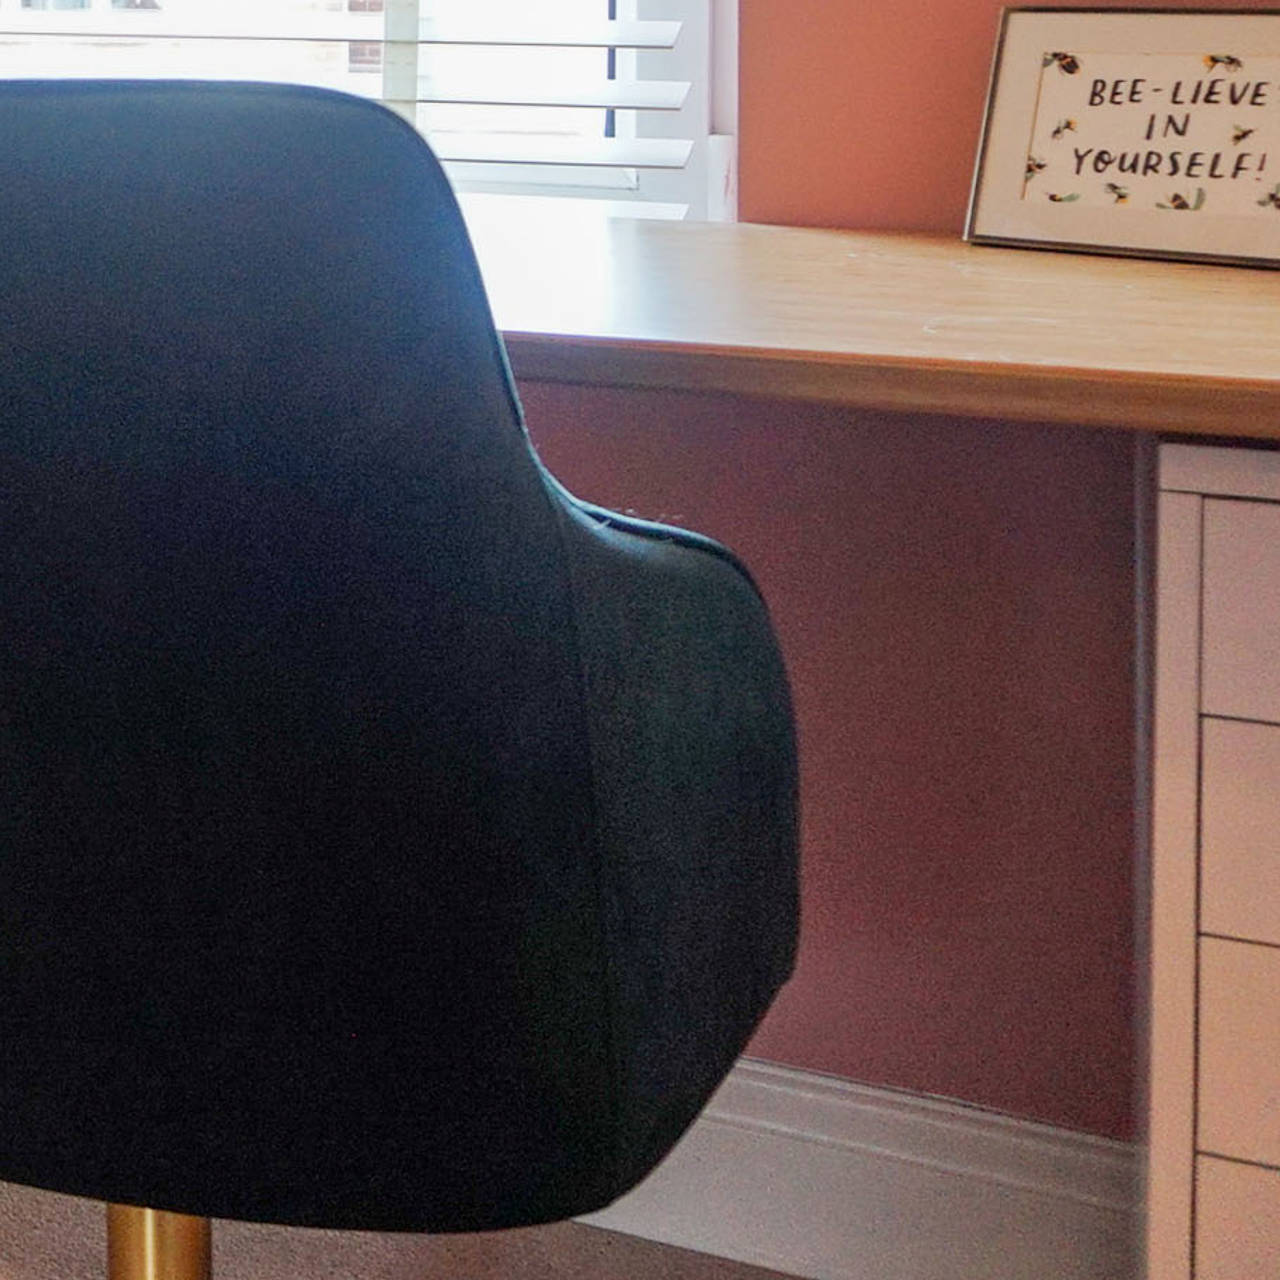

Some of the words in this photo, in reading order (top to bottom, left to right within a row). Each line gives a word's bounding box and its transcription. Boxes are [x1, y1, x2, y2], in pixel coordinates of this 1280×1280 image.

[1088, 78, 1271, 107] BEE-LIEVE
[1144, 113, 1191, 141] IN
[1073, 147, 1267, 181] YOURSELF!
